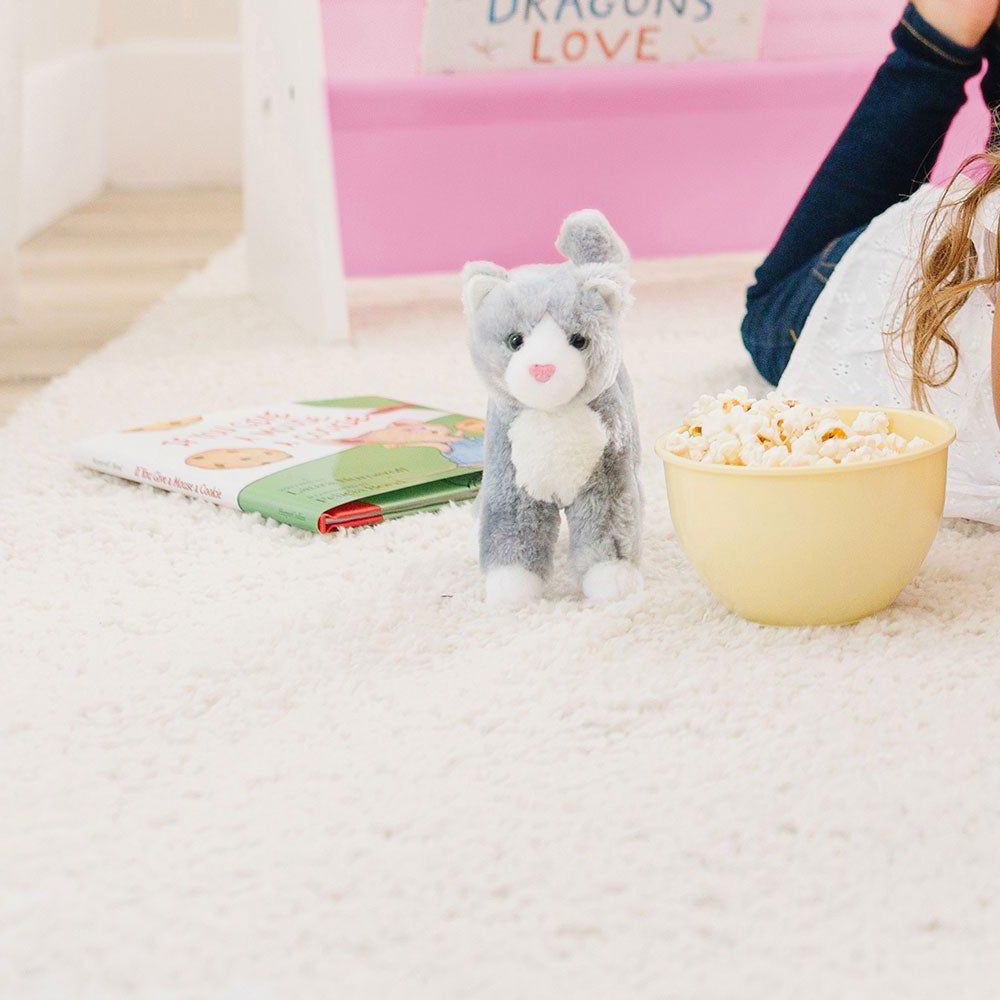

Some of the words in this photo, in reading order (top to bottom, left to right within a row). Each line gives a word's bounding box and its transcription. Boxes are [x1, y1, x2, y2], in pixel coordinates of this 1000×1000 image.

[531, 24, 661, 64] LOVE
[173, 475, 194, 493] Mouse
[199, 483, 222, 500] Cookie
